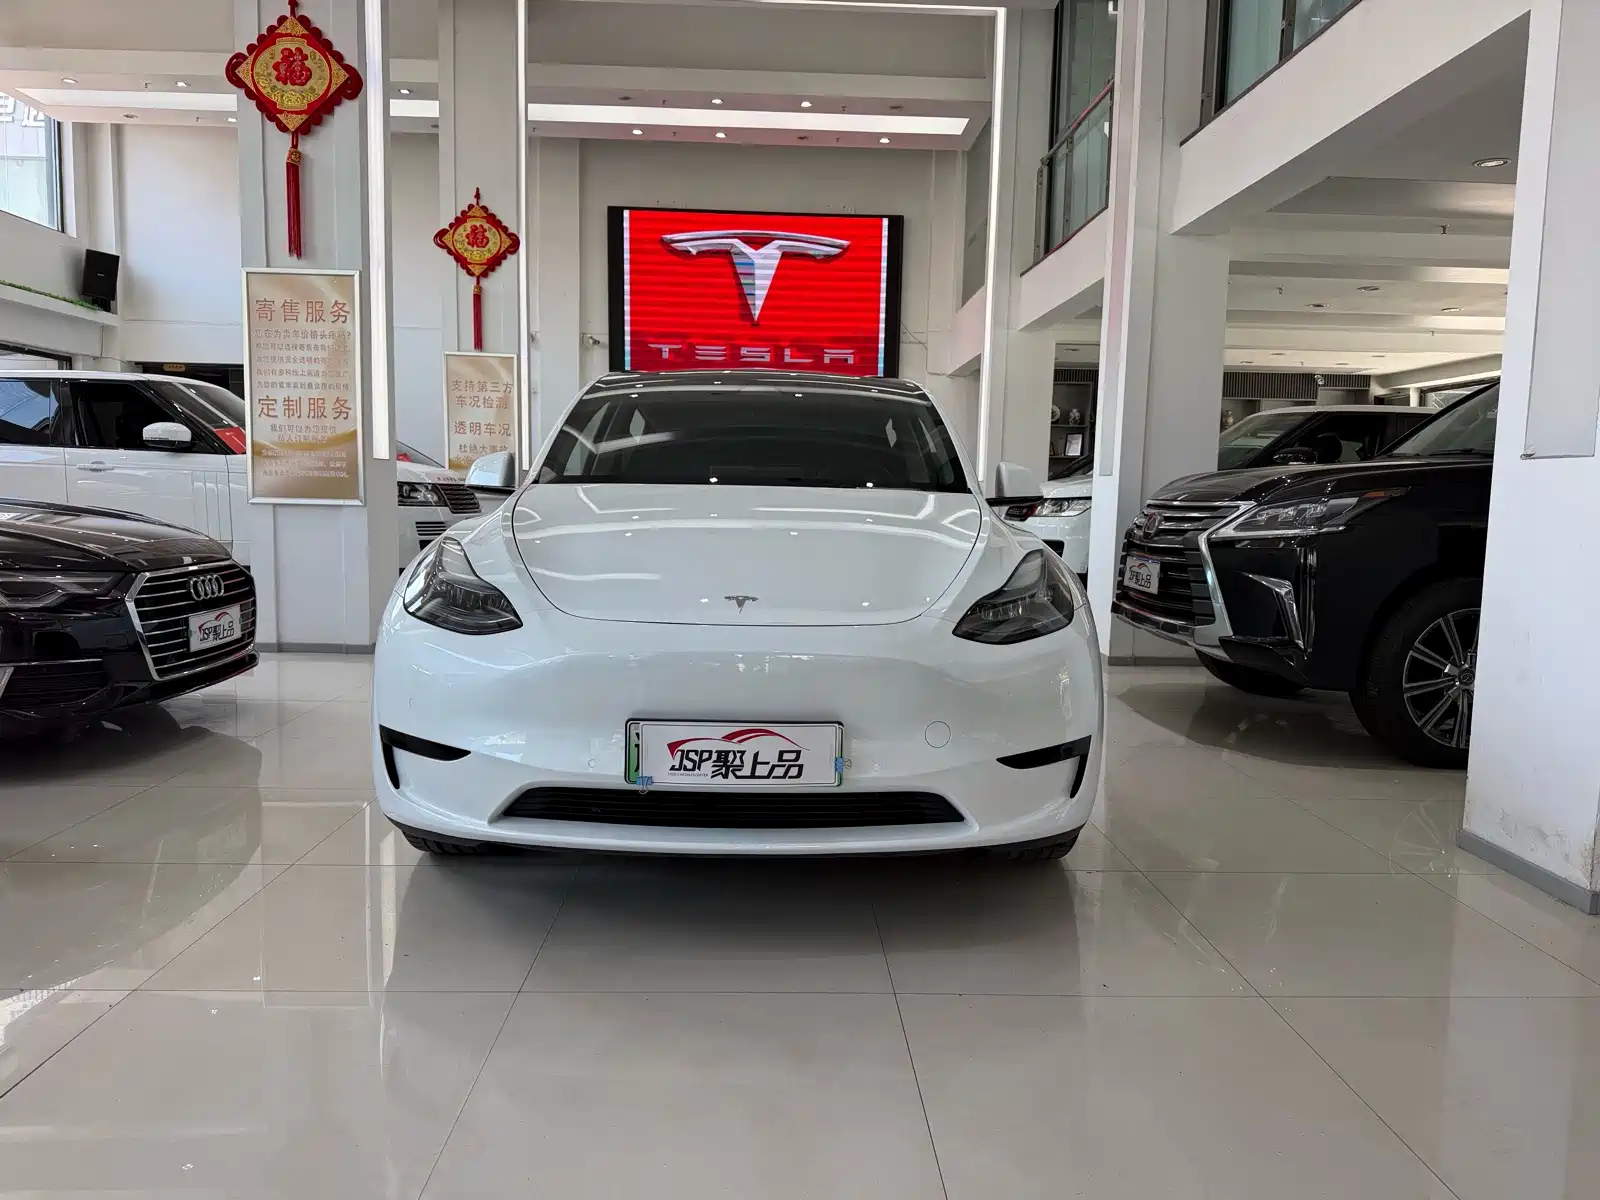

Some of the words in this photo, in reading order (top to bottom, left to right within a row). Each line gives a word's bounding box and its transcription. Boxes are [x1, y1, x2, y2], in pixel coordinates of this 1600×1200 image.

[272, 47, 312, 86] 福
[465, 224, 489, 248] 福
[255, 297, 351, 324] 寄售服务
[648, 344, 854, 364] TESLA
[451, 380, 514, 394] 支持第三方
[258, 395, 352, 420] 定制服务
[456, 395, 508, 409] 车况检测
[453, 421, 511, 436] 透明车况
